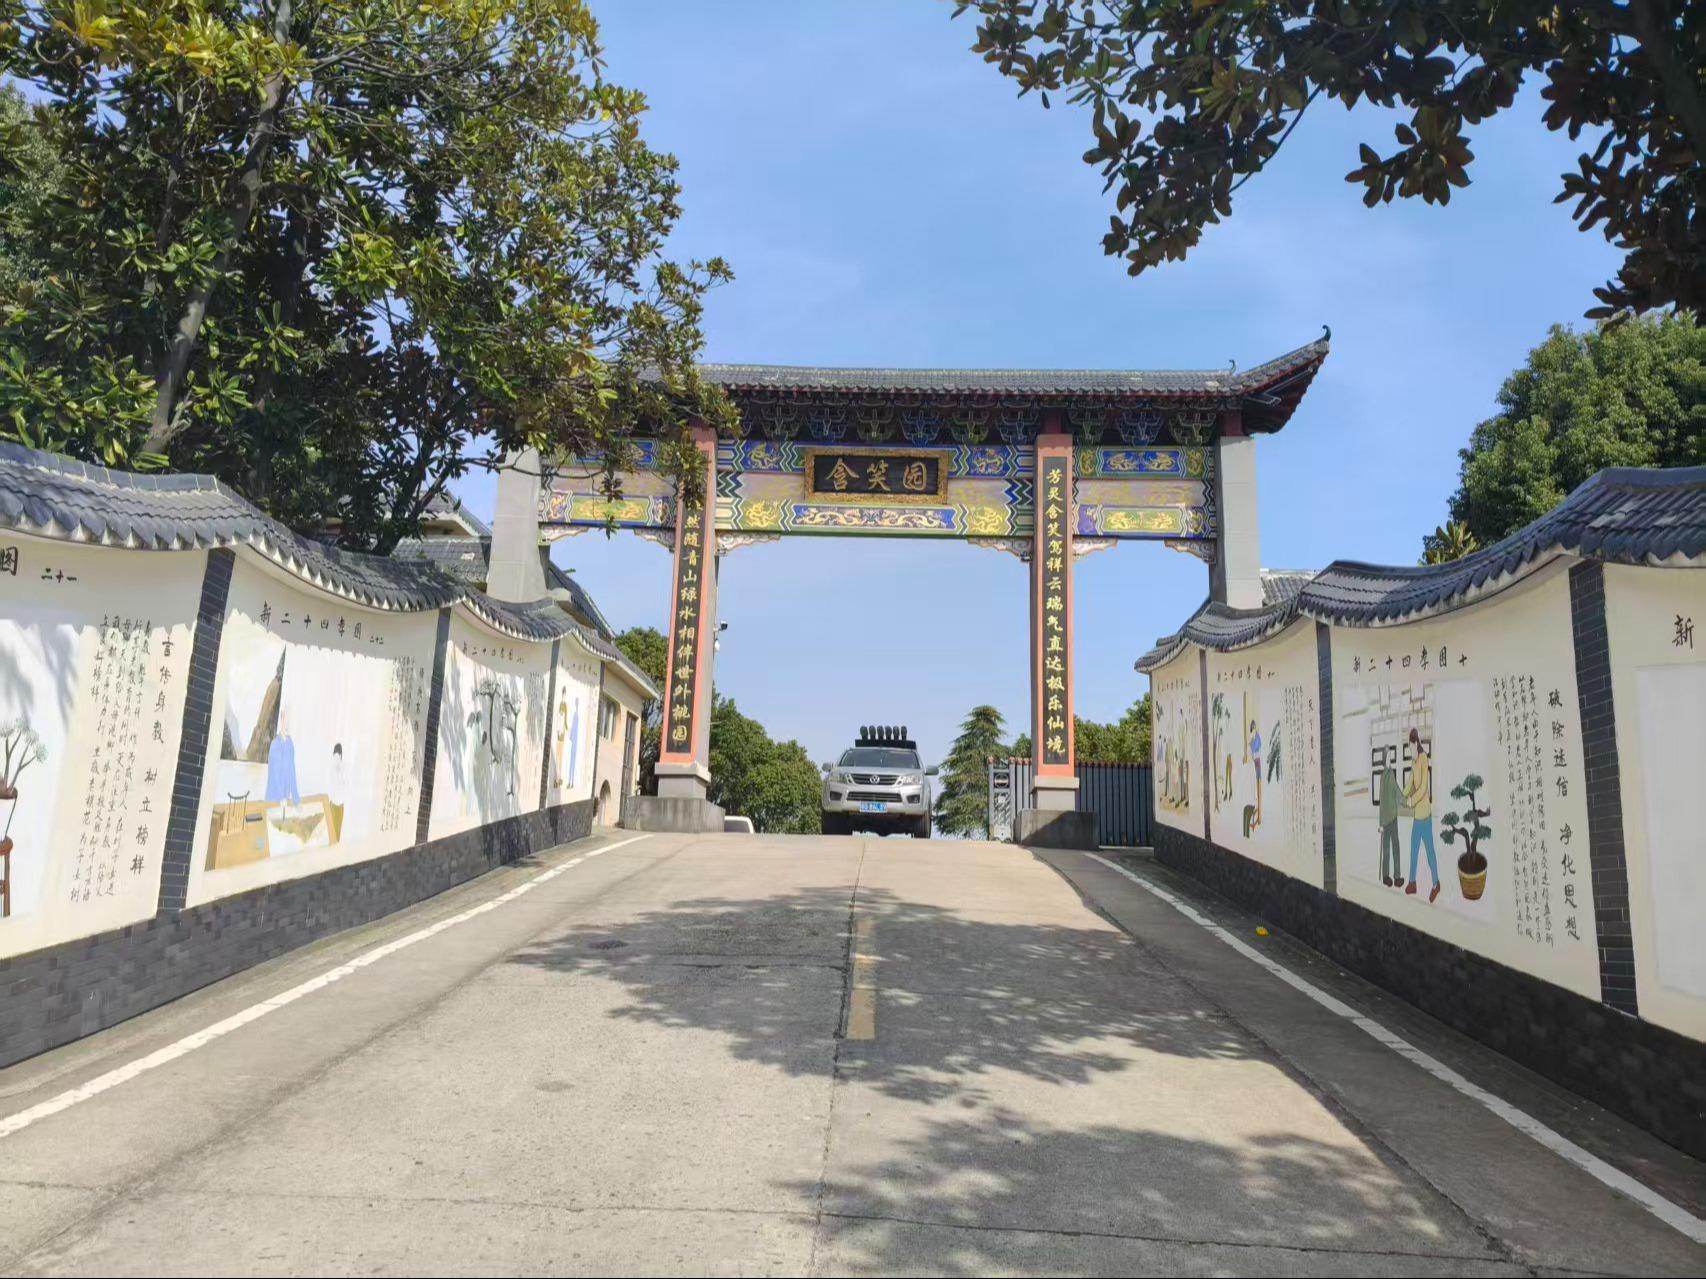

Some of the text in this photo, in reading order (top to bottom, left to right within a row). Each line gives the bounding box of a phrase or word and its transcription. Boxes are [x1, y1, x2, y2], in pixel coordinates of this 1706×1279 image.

[825, 457, 927, 491] 含笑园
[41, 567, 77, 583] 二十一
[1672, 614, 1694, 650] 新
